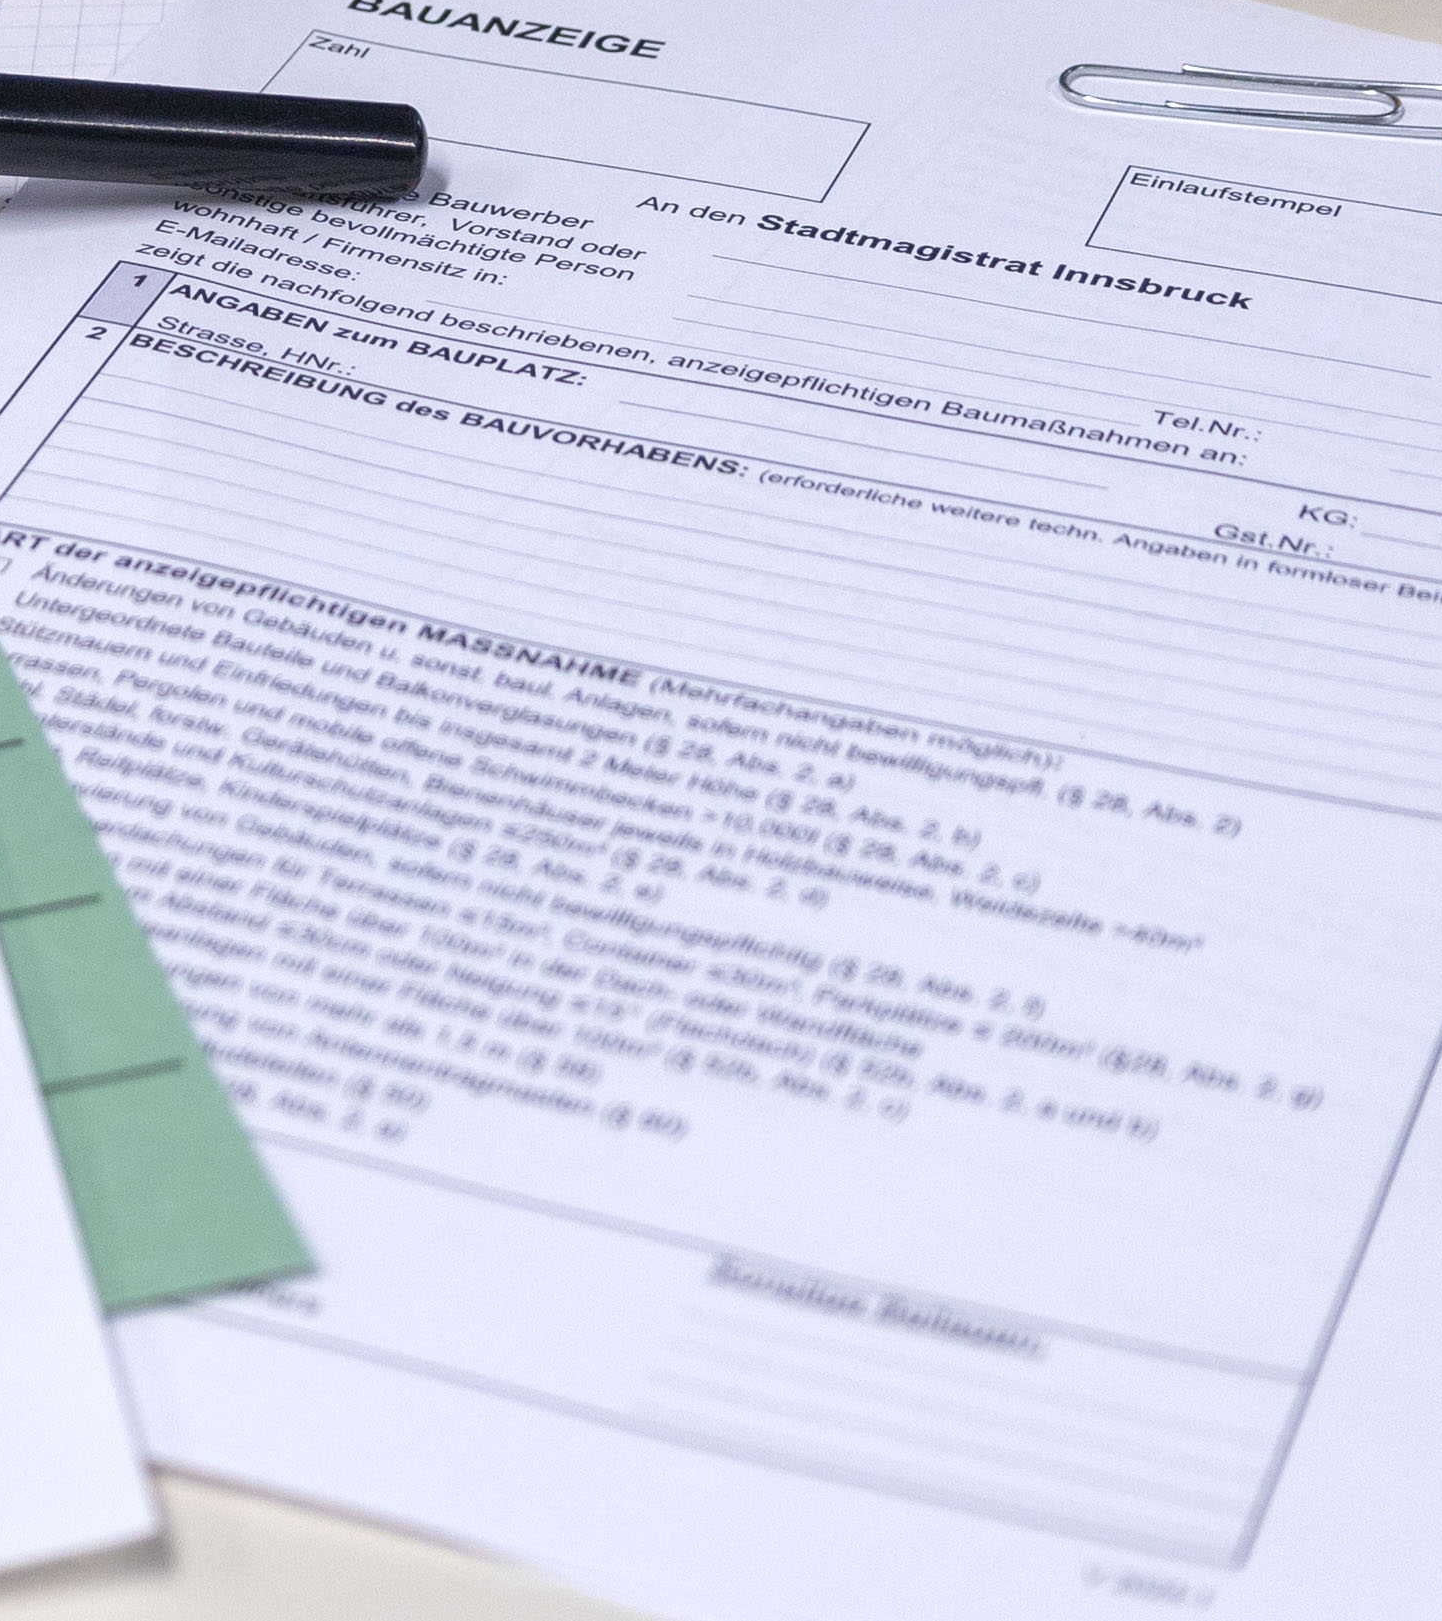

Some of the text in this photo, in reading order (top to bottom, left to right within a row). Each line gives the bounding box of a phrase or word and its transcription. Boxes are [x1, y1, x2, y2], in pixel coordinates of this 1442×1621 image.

[308, 35, 370, 58] Zahl
[428, 188, 594, 229] Bauwerber
[1129, 172, 1342, 217] Einlaufstempel
[154, 219, 360, 281] E-Mailadresse:
[174, 200, 298, 240] wohnhaft
[301, 233, 319, 243] /
[321, 237, 467, 278] Firmensitz
[472, 268, 507, 285] in:
[310, 209, 526, 262] bevollmächtigte
[534, 253, 634, 280] Person
[452, 217, 646, 260] Vorstand oder
[635, 196, 1252, 309] An den Stadtmagistrat Innsbruck
[133, 274, 586, 385] 1 ANGABEN zum BAUPLATZ:
[135, 243, 1246, 465] zeigt die nachfolgend beschriebenen, anzeigepflichtigen Baumaßnahmen an:
[157, 315, 355, 375] Strasse, HNr.:
[1154, 409, 1261, 441] Tel.Nr.:
[85, 326, 107, 340] 2
[128, 333, 387, 405] BESCHREIBUNG
[395, 400, 450, 420] des
[459, 411, 748, 477] BAUVORHABENS:
[758, 470, 922, 508] (erforderliche
[931, 502, 1019, 525] weitere
[1113, 533, 1227, 563] Angaben
[1236, 556, 1258, 569] in
[1268, 561, 1385, 592] formloser
[1298, 504, 1357, 527] KG:
